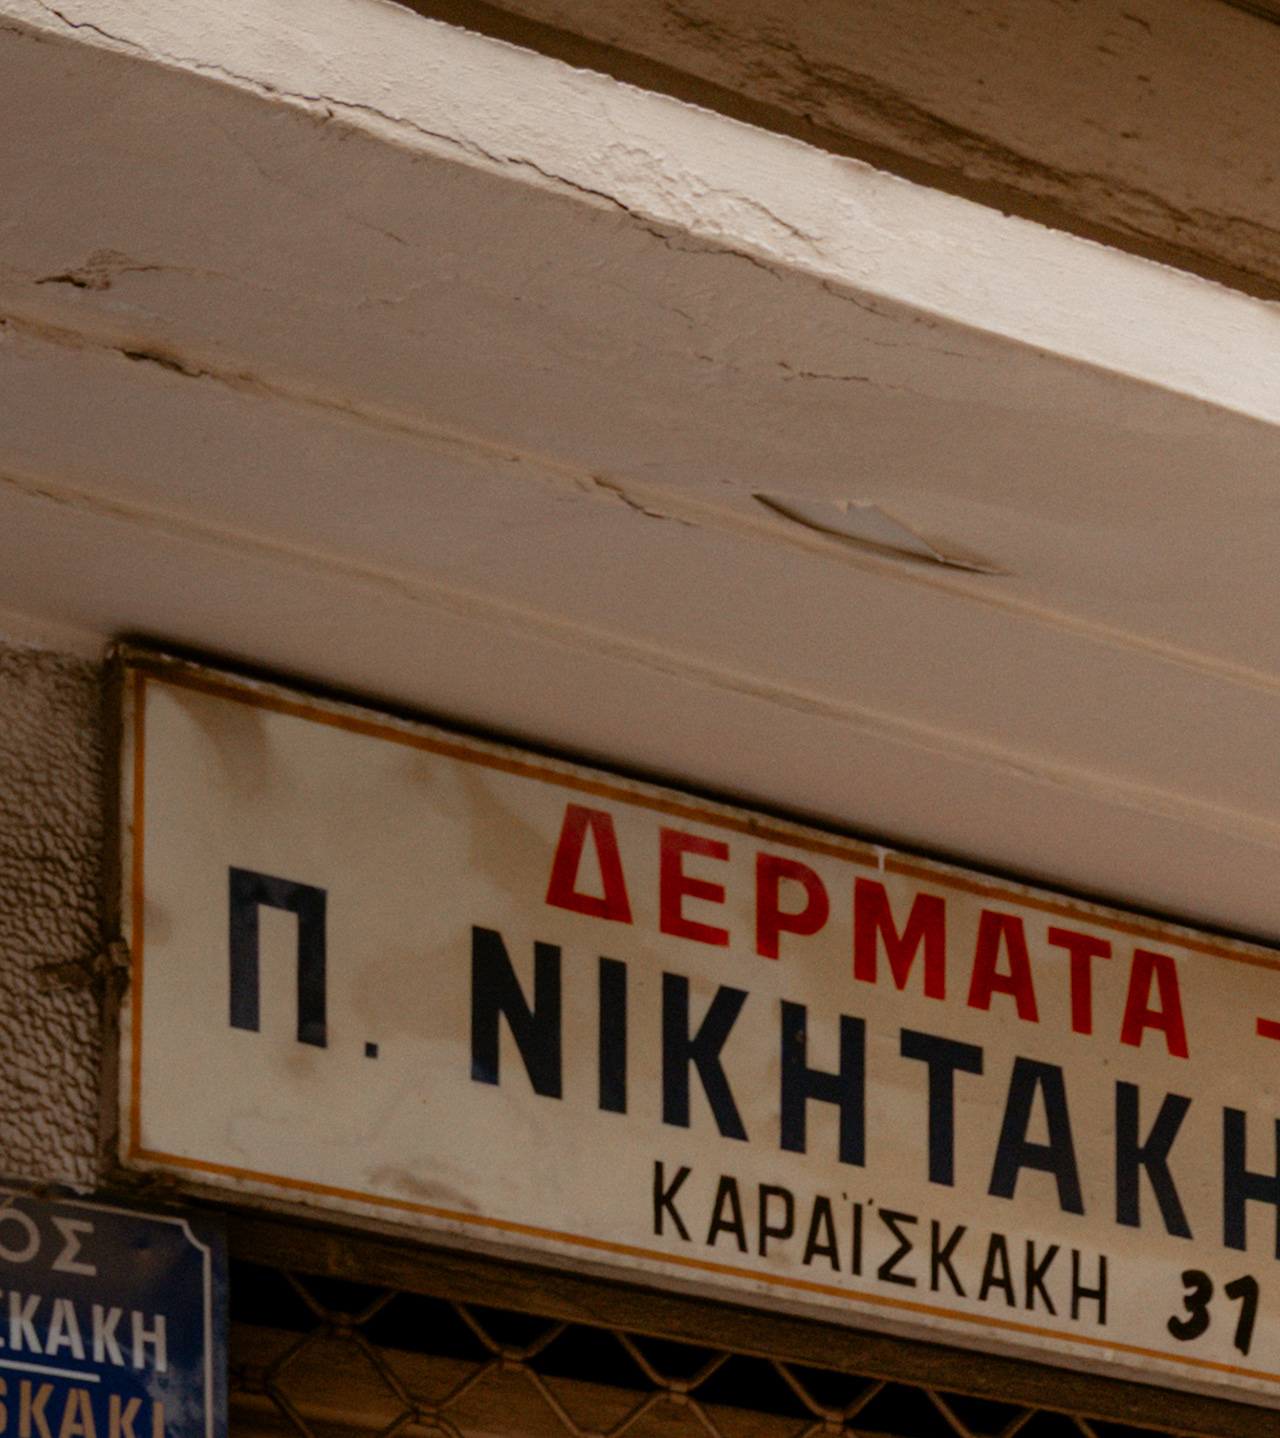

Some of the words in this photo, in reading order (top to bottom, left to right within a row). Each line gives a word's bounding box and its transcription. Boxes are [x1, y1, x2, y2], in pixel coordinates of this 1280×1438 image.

[545, 801, 1191, 1060] ΔΕΡΜΑΤΑ
[0, 1290, 168, 1373] ΚΑΚΗ
[653, 1158, 1109, 1327] ΚΑΡΑΪΣΚΑΚΗ
[1166, 1268, 1260, 1357] 31
